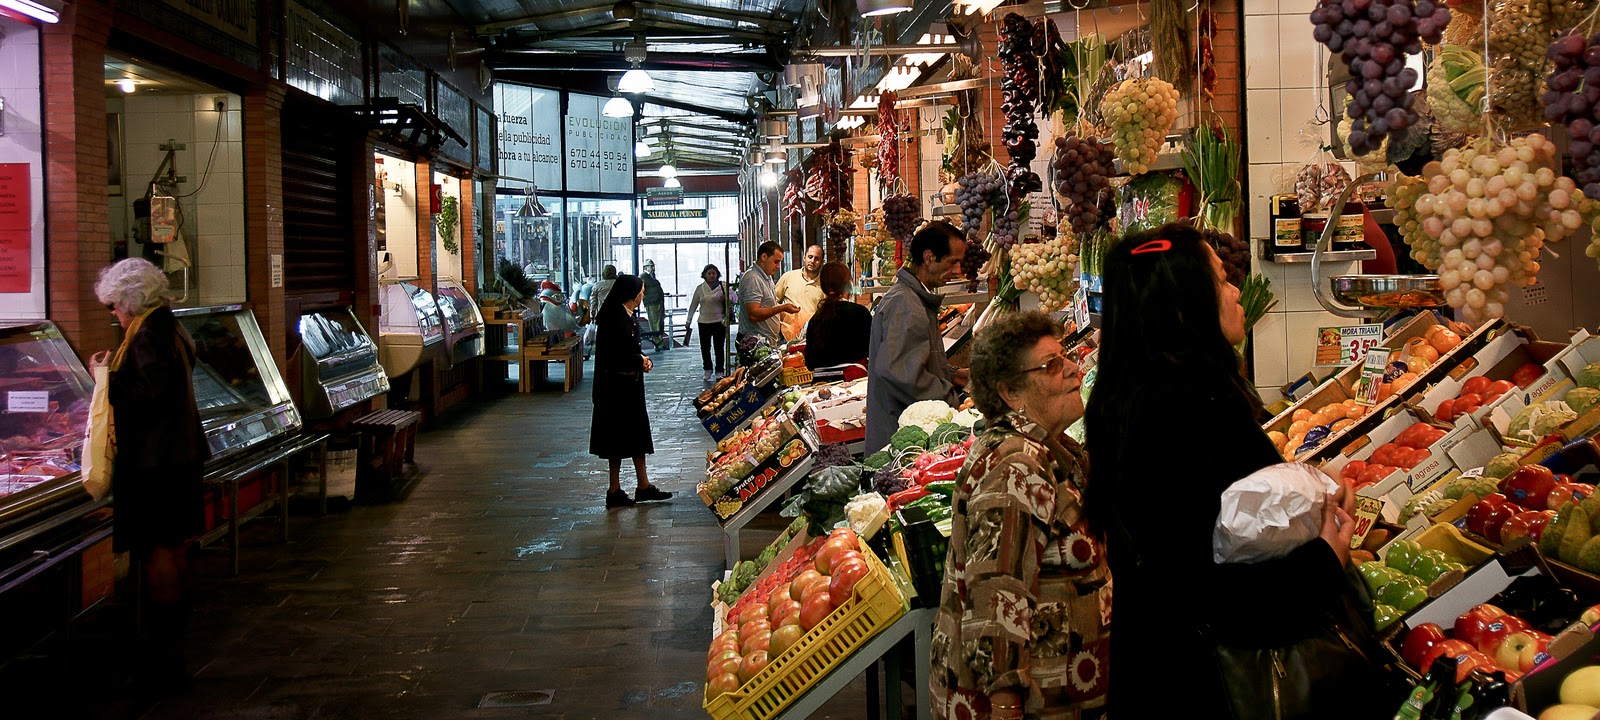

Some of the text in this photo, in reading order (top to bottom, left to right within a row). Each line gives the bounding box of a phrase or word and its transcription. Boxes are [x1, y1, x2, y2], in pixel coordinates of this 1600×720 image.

[503, 111, 527, 126] fuerza
[568, 117, 627, 132] EVOLUCIÓN
[505, 130, 512, 142] la
[513, 132, 551, 146] publicidad
[568, 129, 627, 141] PUBLICIDAD
[498, 148, 559, 164] hora a tu alcance
[570, 148, 628, 161] 670 44 50 54
[570, 159, 628, 172] 670 44 51 20
[679, 210, 703, 218] PUENTE
[1359, 326, 1379, 335] TRIANA
[1531, 376, 1557, 399] agrasa
[726, 407, 746, 424] FAISAL
[1413, 460, 1440, 482] agrasa
[733, 474, 755, 494] Frutas
[739, 467, 777, 503] ALOA
